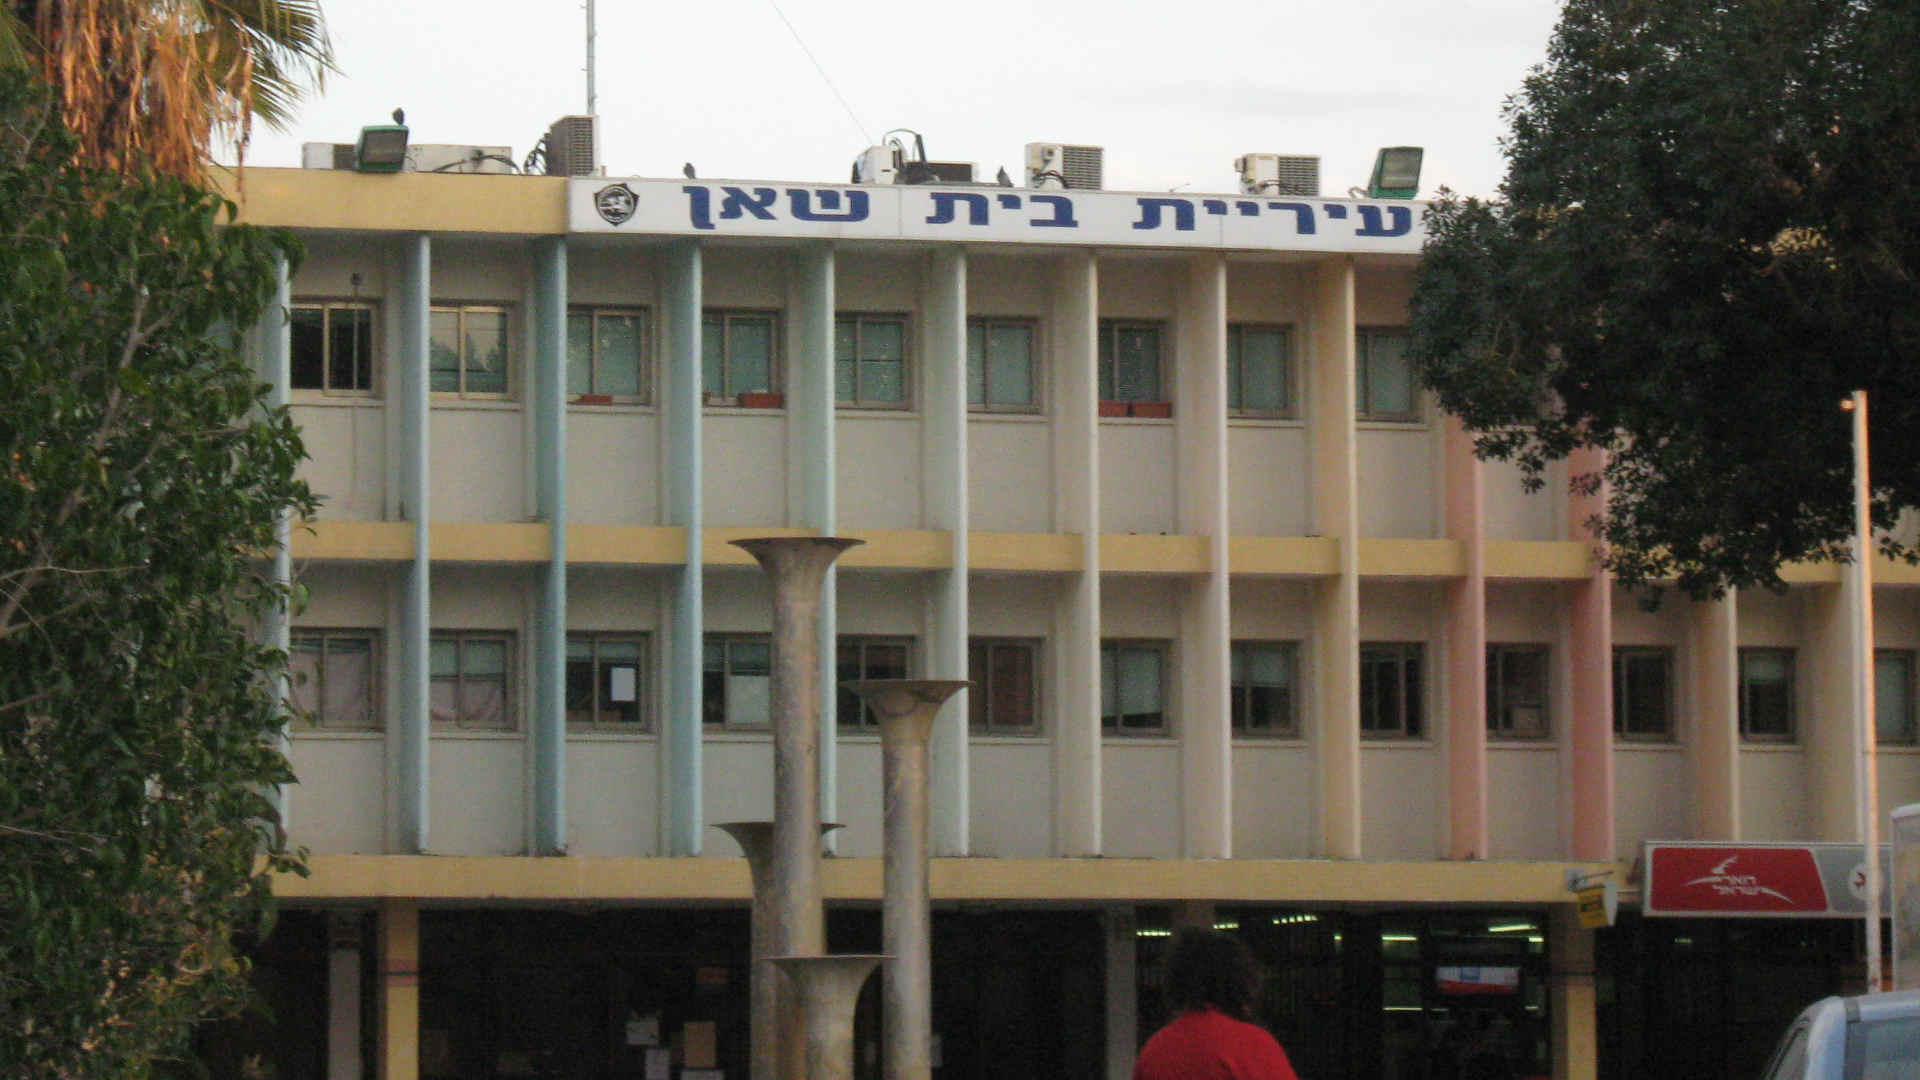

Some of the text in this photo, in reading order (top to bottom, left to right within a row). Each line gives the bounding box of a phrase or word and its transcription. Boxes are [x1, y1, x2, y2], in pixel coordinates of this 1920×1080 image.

[682, 185, 1412, 237] עיריית בית שאן
